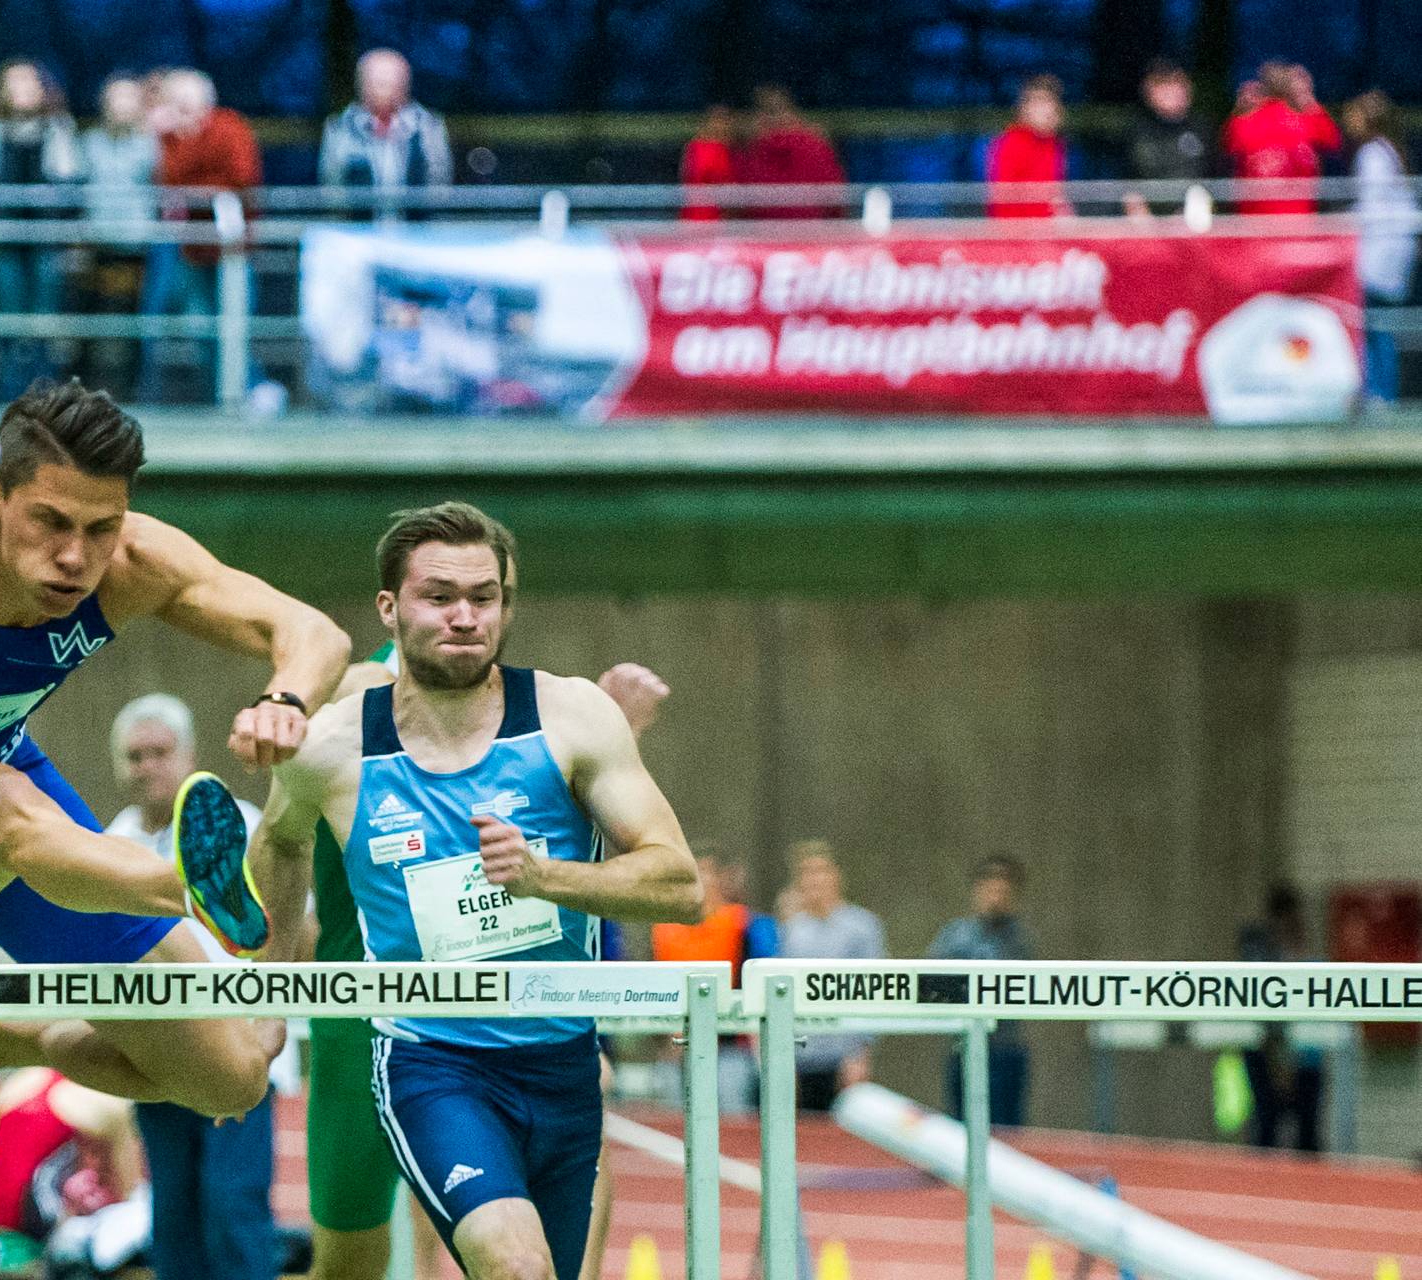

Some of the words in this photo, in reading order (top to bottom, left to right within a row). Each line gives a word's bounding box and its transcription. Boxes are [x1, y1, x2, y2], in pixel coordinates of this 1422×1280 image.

[761, 248, 1107, 315] Erlebniswelt
[672, 325, 772, 375] am
[777, 309, 1196, 385] Hauptbahnhof
[458, 890, 513, 915] ELGER
[480, 915, 499, 931] 22
[513, 919, 553, 938] Dortmund
[39, 969, 498, 1005] HELMUT-KÖRNIG-HALLE
[540, 989, 575, 1002] Indoor
[578, 989, 620, 1005] Meeting
[624, 989, 679, 1002] Dortmund
[807, 973, 911, 1001] SCHÄPER
